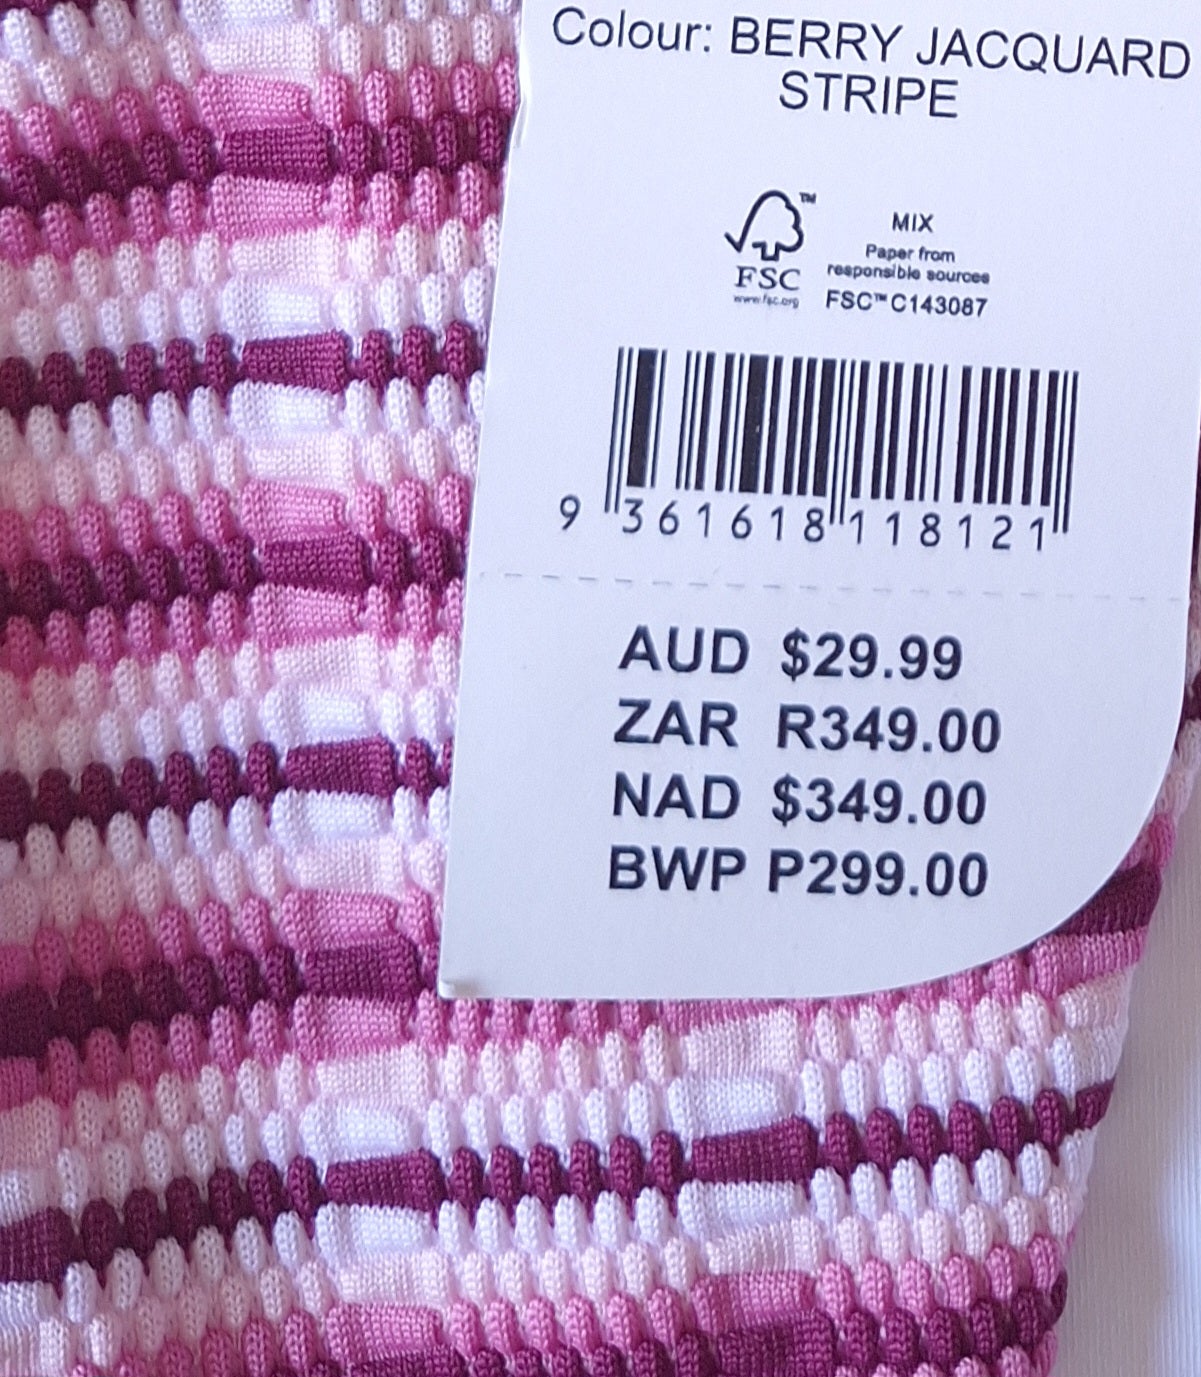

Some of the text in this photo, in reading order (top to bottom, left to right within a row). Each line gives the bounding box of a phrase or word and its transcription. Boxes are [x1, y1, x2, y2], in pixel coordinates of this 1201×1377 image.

[553, 7, 1191, 81] Colour: BERRY JACQUARD
[780, 71, 958, 118] STRIPE
[893, 212, 933, 232] MIX
[828, 264, 989, 284] responsible sources
[866, 244, 955, 262] Paper from
[736, 266, 800, 290] FSC
[619, 626, 961, 682] AUD $29.99
[614, 699, 1000, 753] ZAR R349.00
[613, 773, 985, 827] NAD $349.00
[609, 846, 987, 897] BWP P299.00
